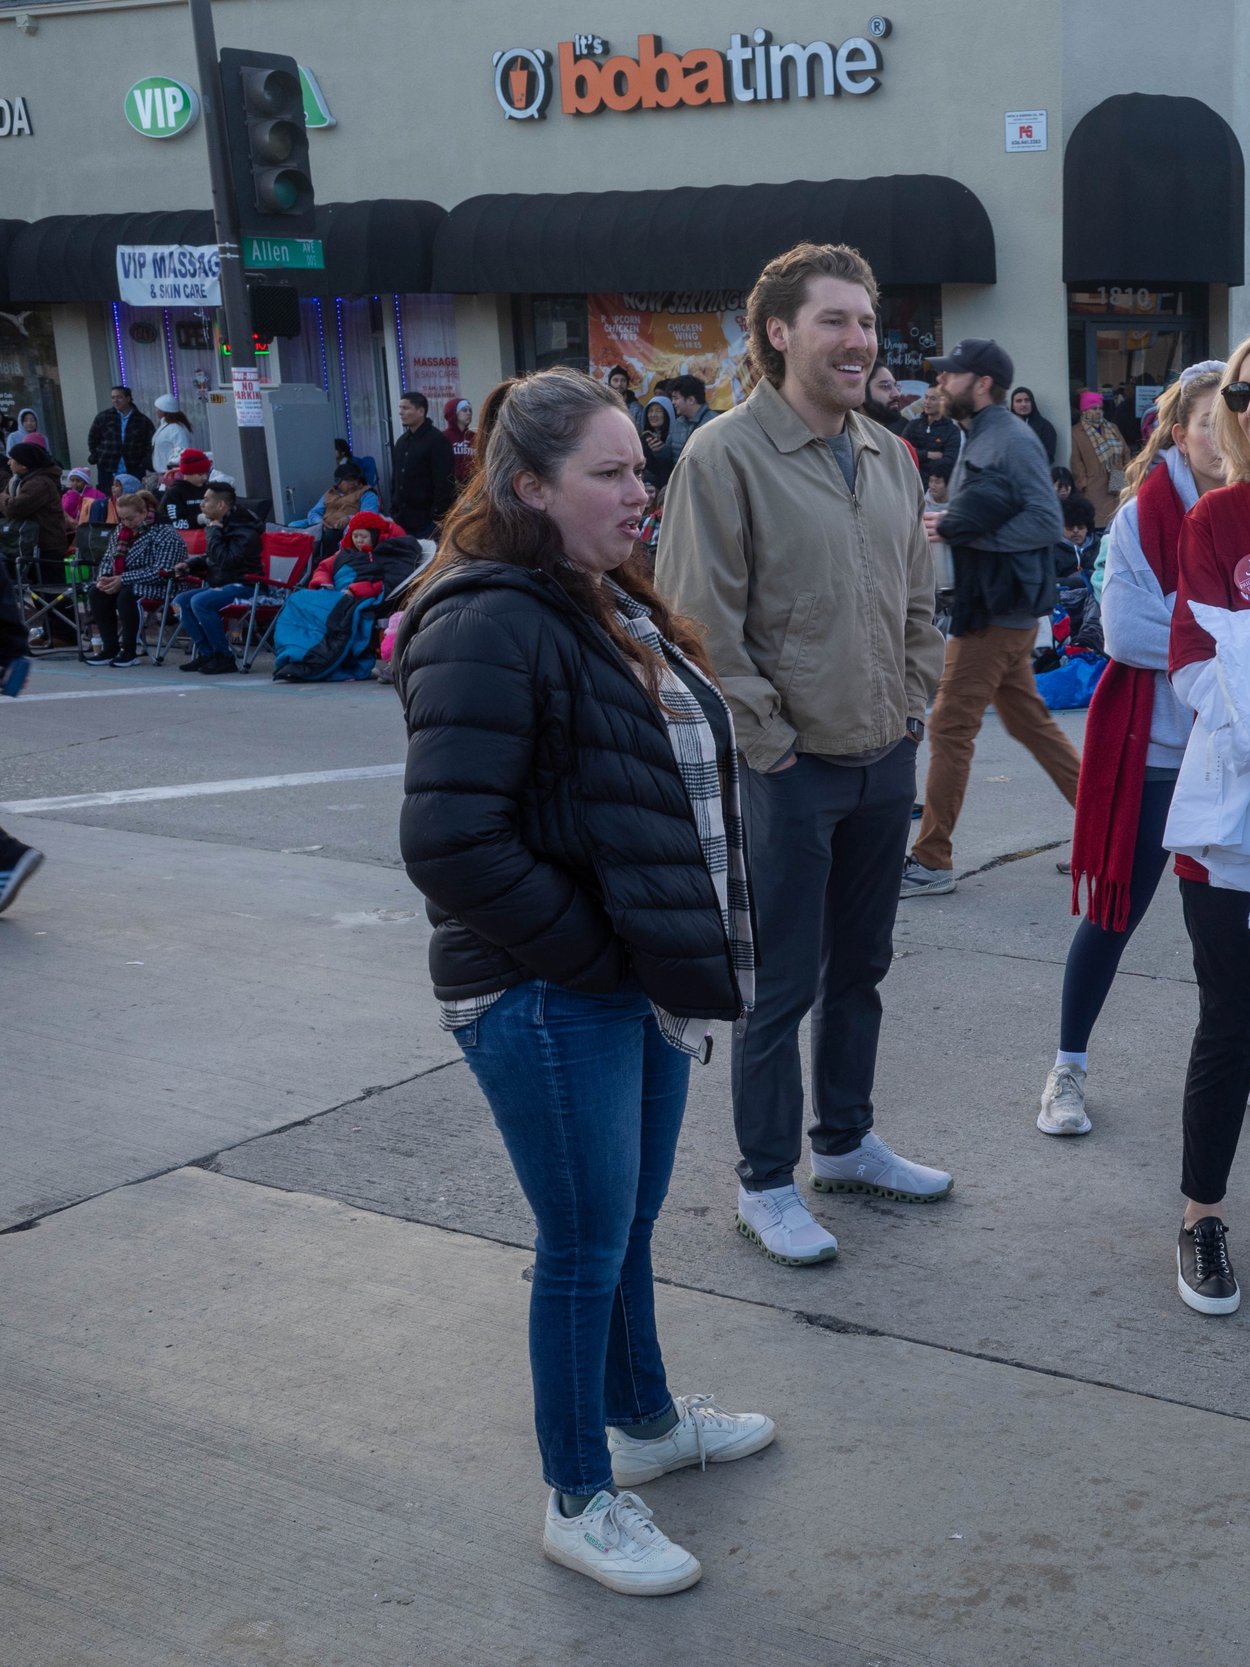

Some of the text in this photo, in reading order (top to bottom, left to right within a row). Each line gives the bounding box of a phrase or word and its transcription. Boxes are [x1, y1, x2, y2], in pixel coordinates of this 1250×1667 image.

[133, 86, 184, 129] VIP
[252, 240, 289, 261] Allen
[120, 252, 147, 279] VIP
[159, 284, 182, 299] SKIN
[184, 284, 208, 299] CARE
[1097, 286, 1150, 306] 1810
[623, 291, 666, 313] NOW
[667, 323, 703, 332] CHICKEN
[674, 332, 698, 341] WING
[413, 356, 457, 367] MASSAGE
[242, 382, 254, 391] NO
